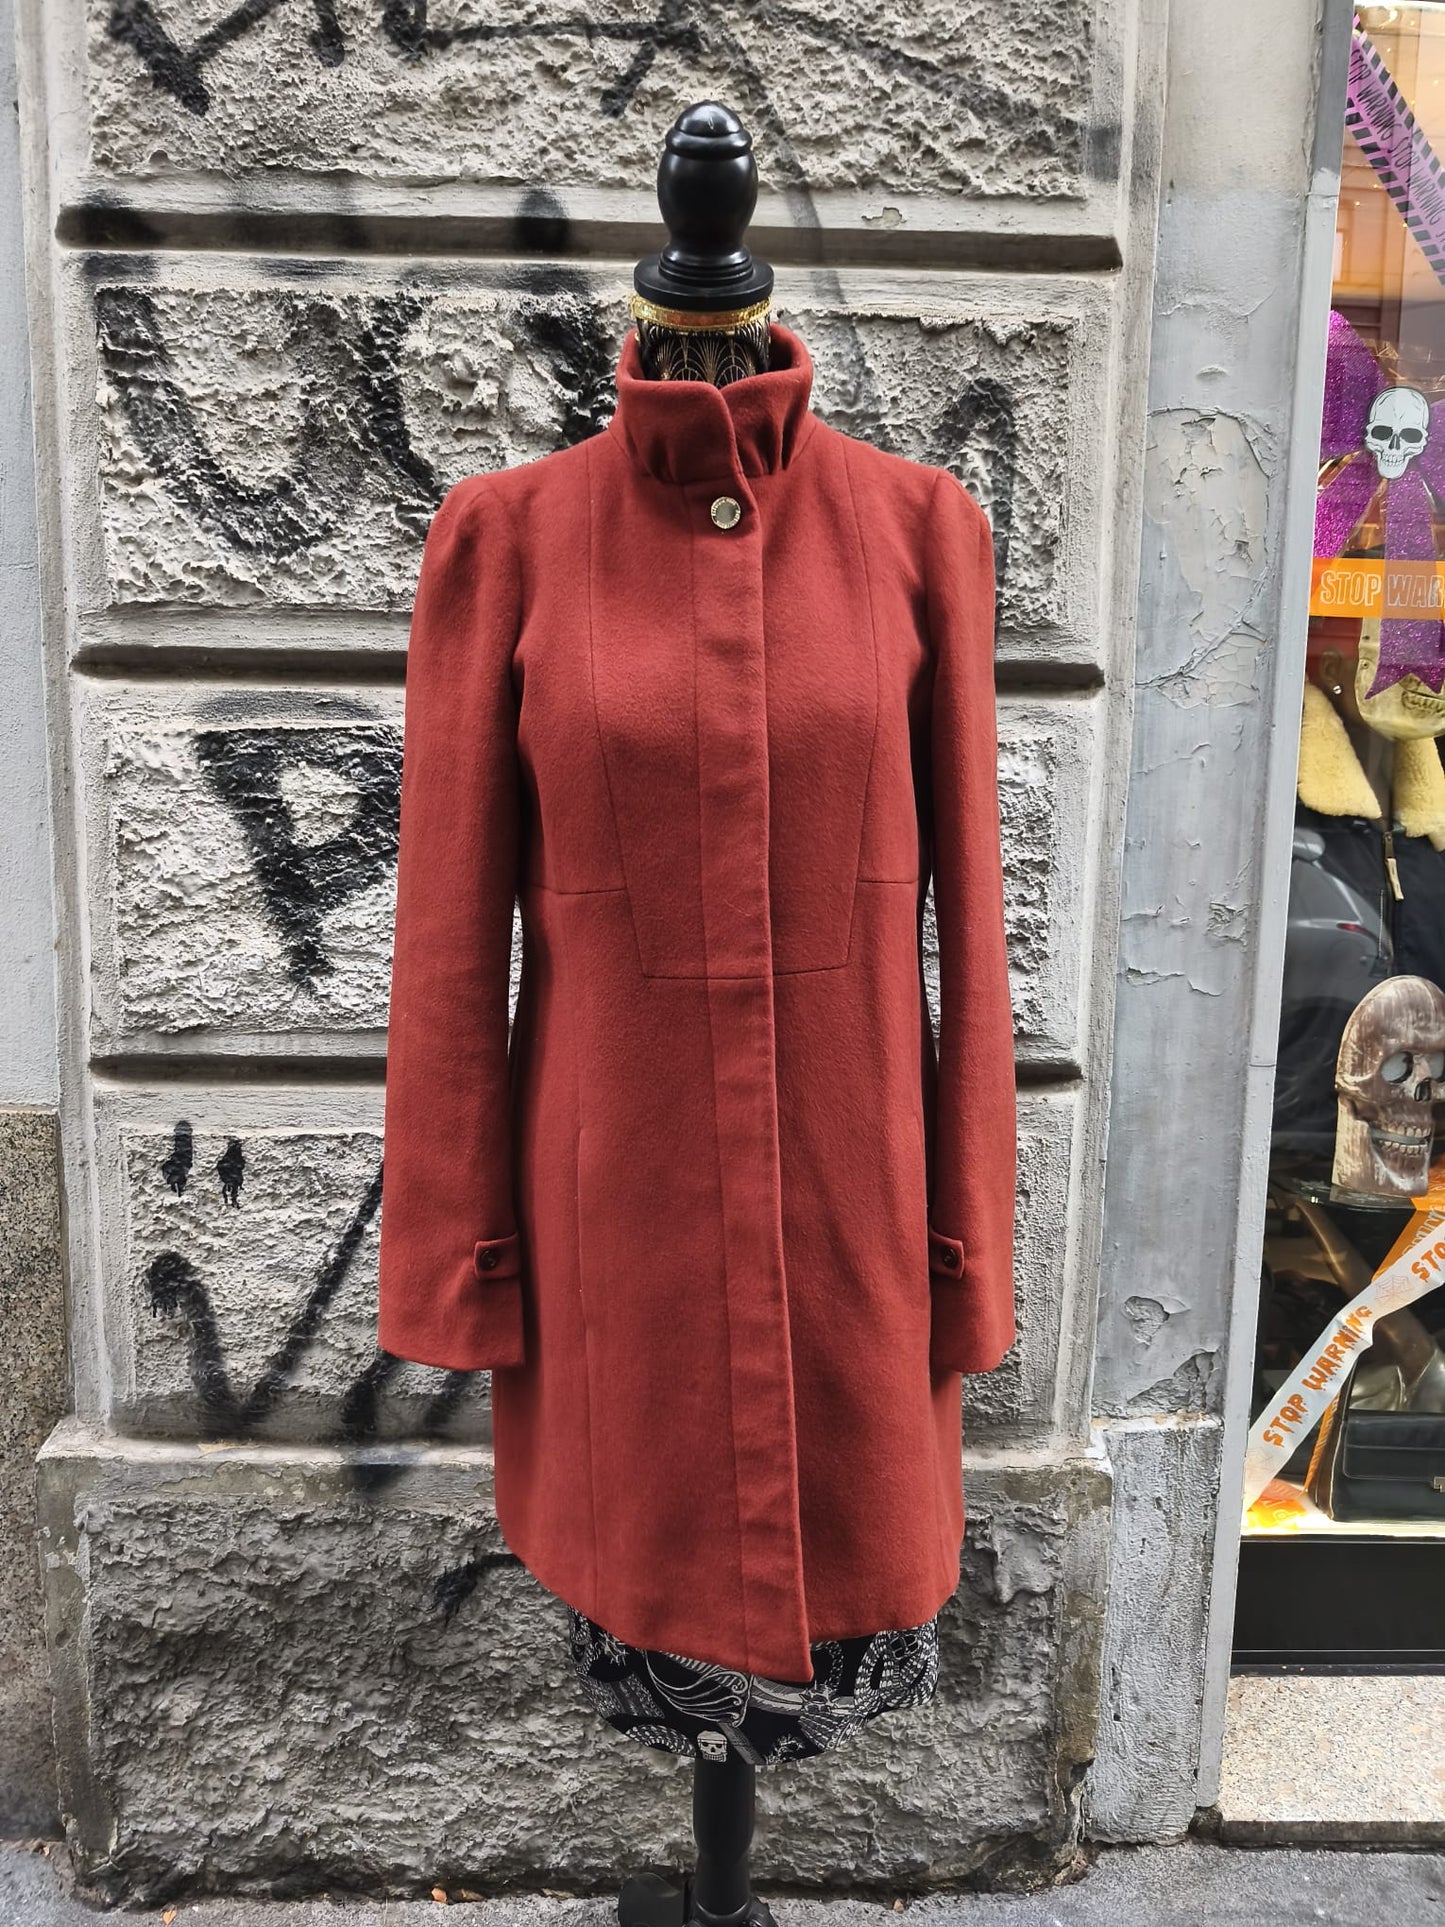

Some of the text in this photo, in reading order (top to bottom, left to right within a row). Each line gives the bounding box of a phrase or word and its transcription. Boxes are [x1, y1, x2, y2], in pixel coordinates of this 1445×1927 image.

[1356, 80, 1403, 141] WARNING
[1387, 136, 1421, 171] STOP
[1406, 167, 1445, 226] WARNING
[1320, 569, 1445, 608] STOP WAR
[1263, 1393, 1309, 1448] STOP
[1301, 1305, 1373, 1391] WARNING
